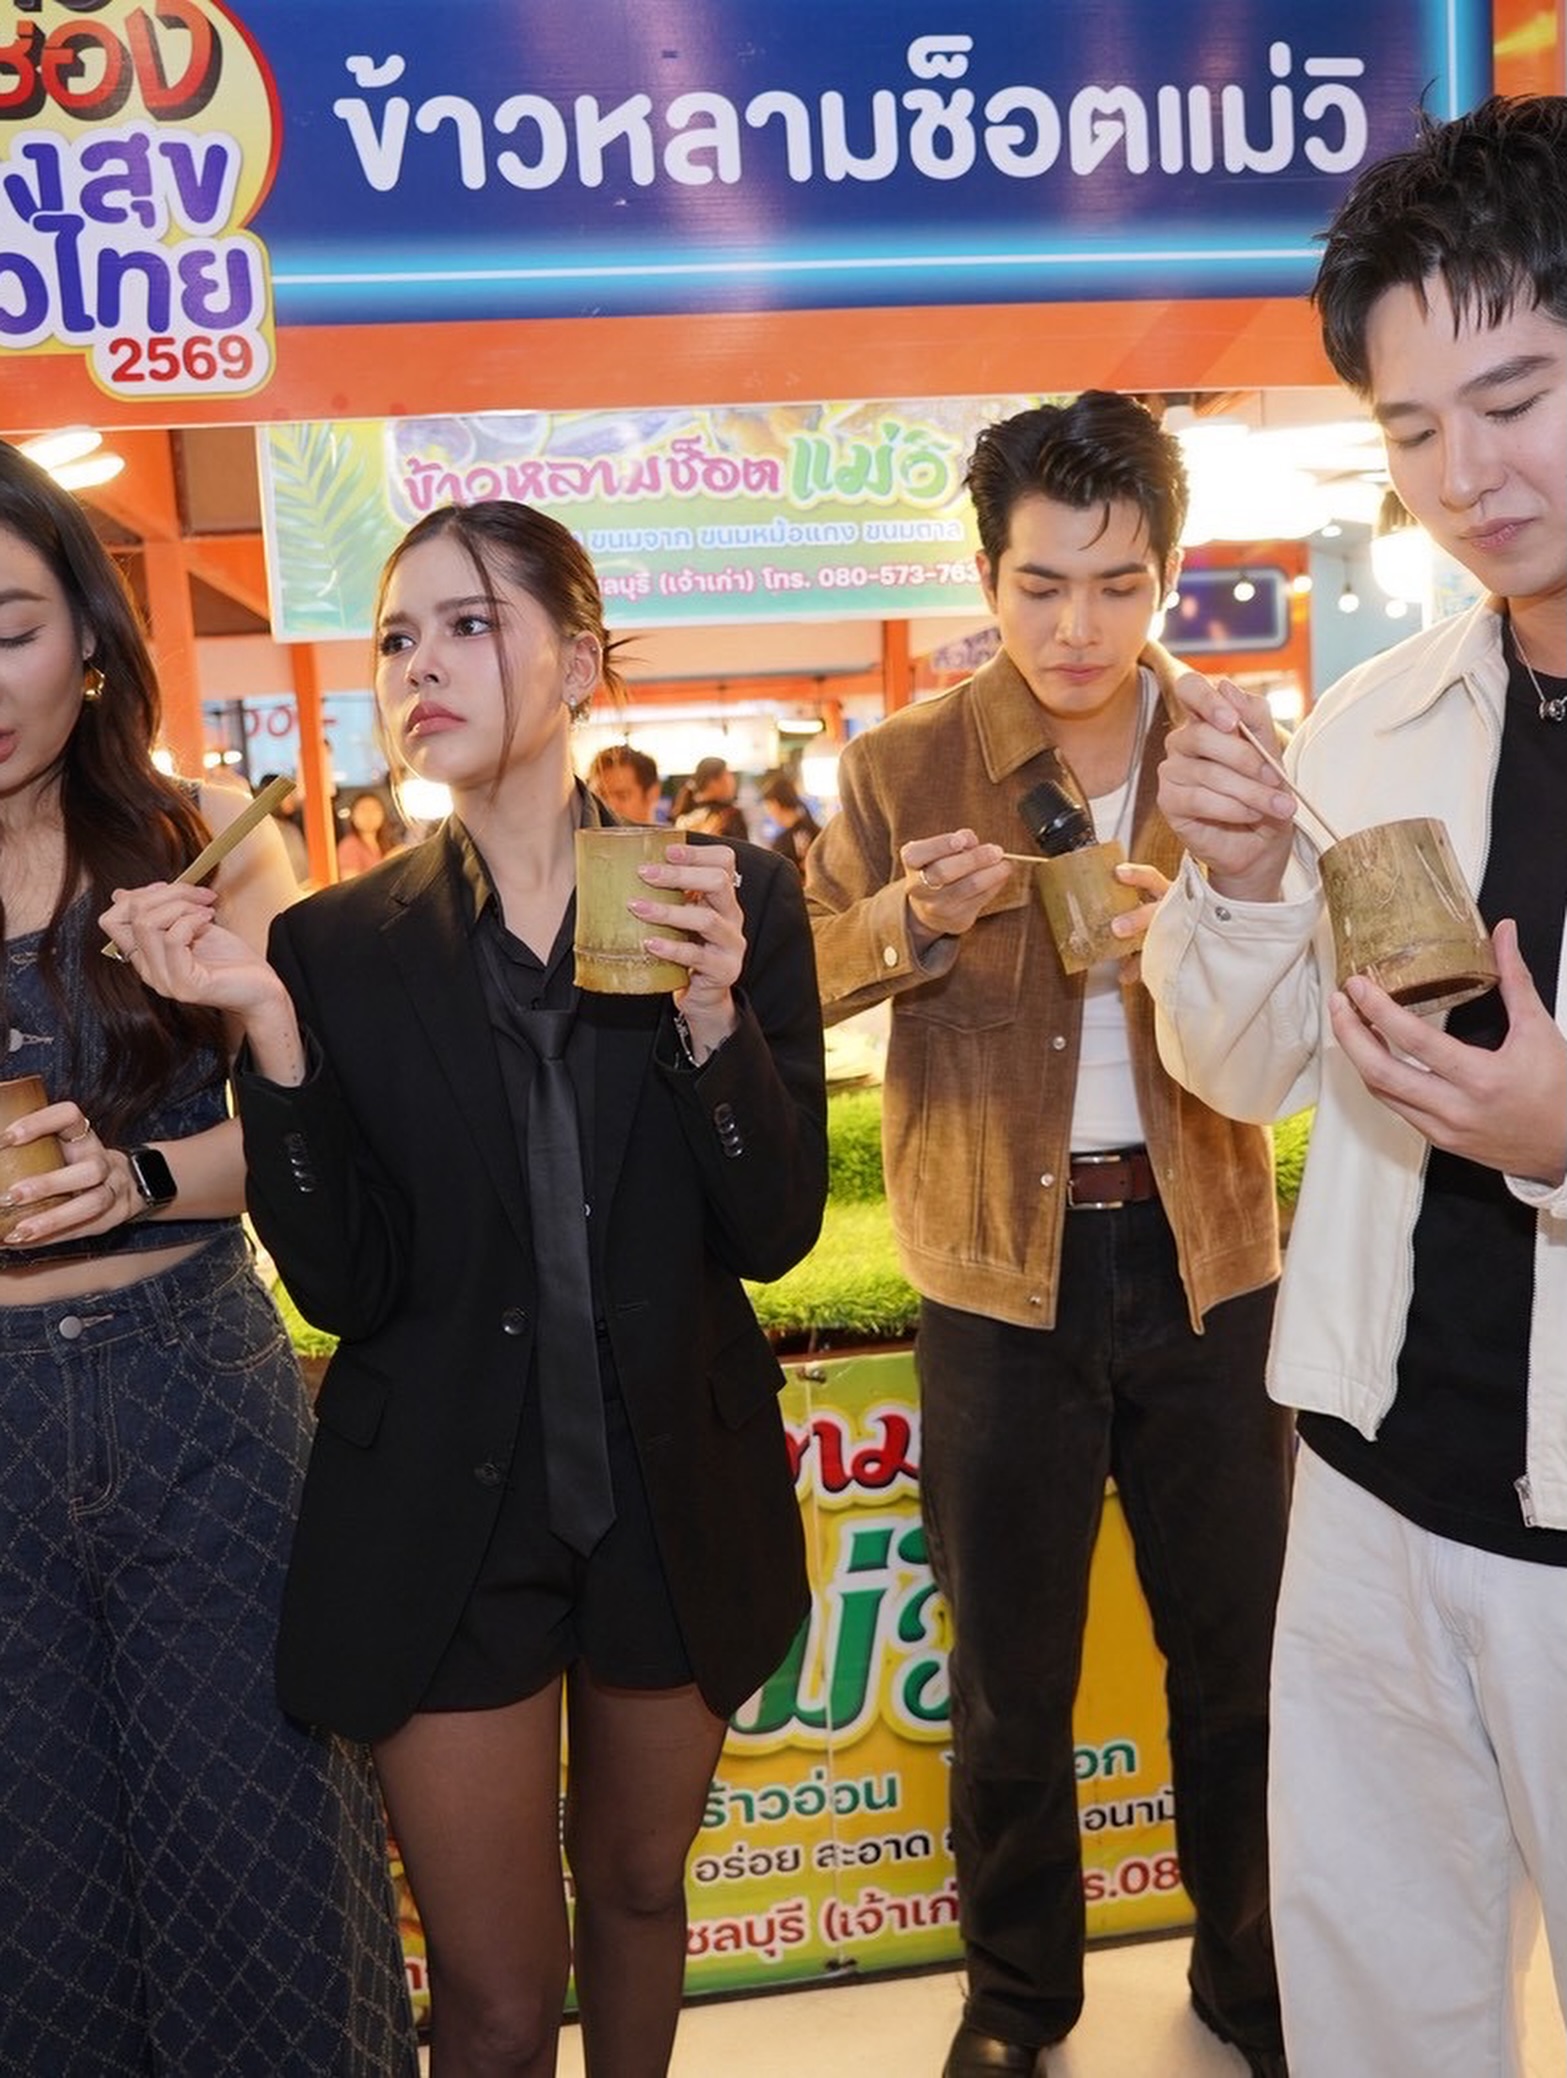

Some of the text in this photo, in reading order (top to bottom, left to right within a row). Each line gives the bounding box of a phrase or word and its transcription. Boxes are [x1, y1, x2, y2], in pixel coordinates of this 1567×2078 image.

[333, 34, 1368, 191] ข้าวหลามช็อตแม่วิ
[108, 335, 253, 382] 2569
[695, 1844, 801, 1883] อร่อย
